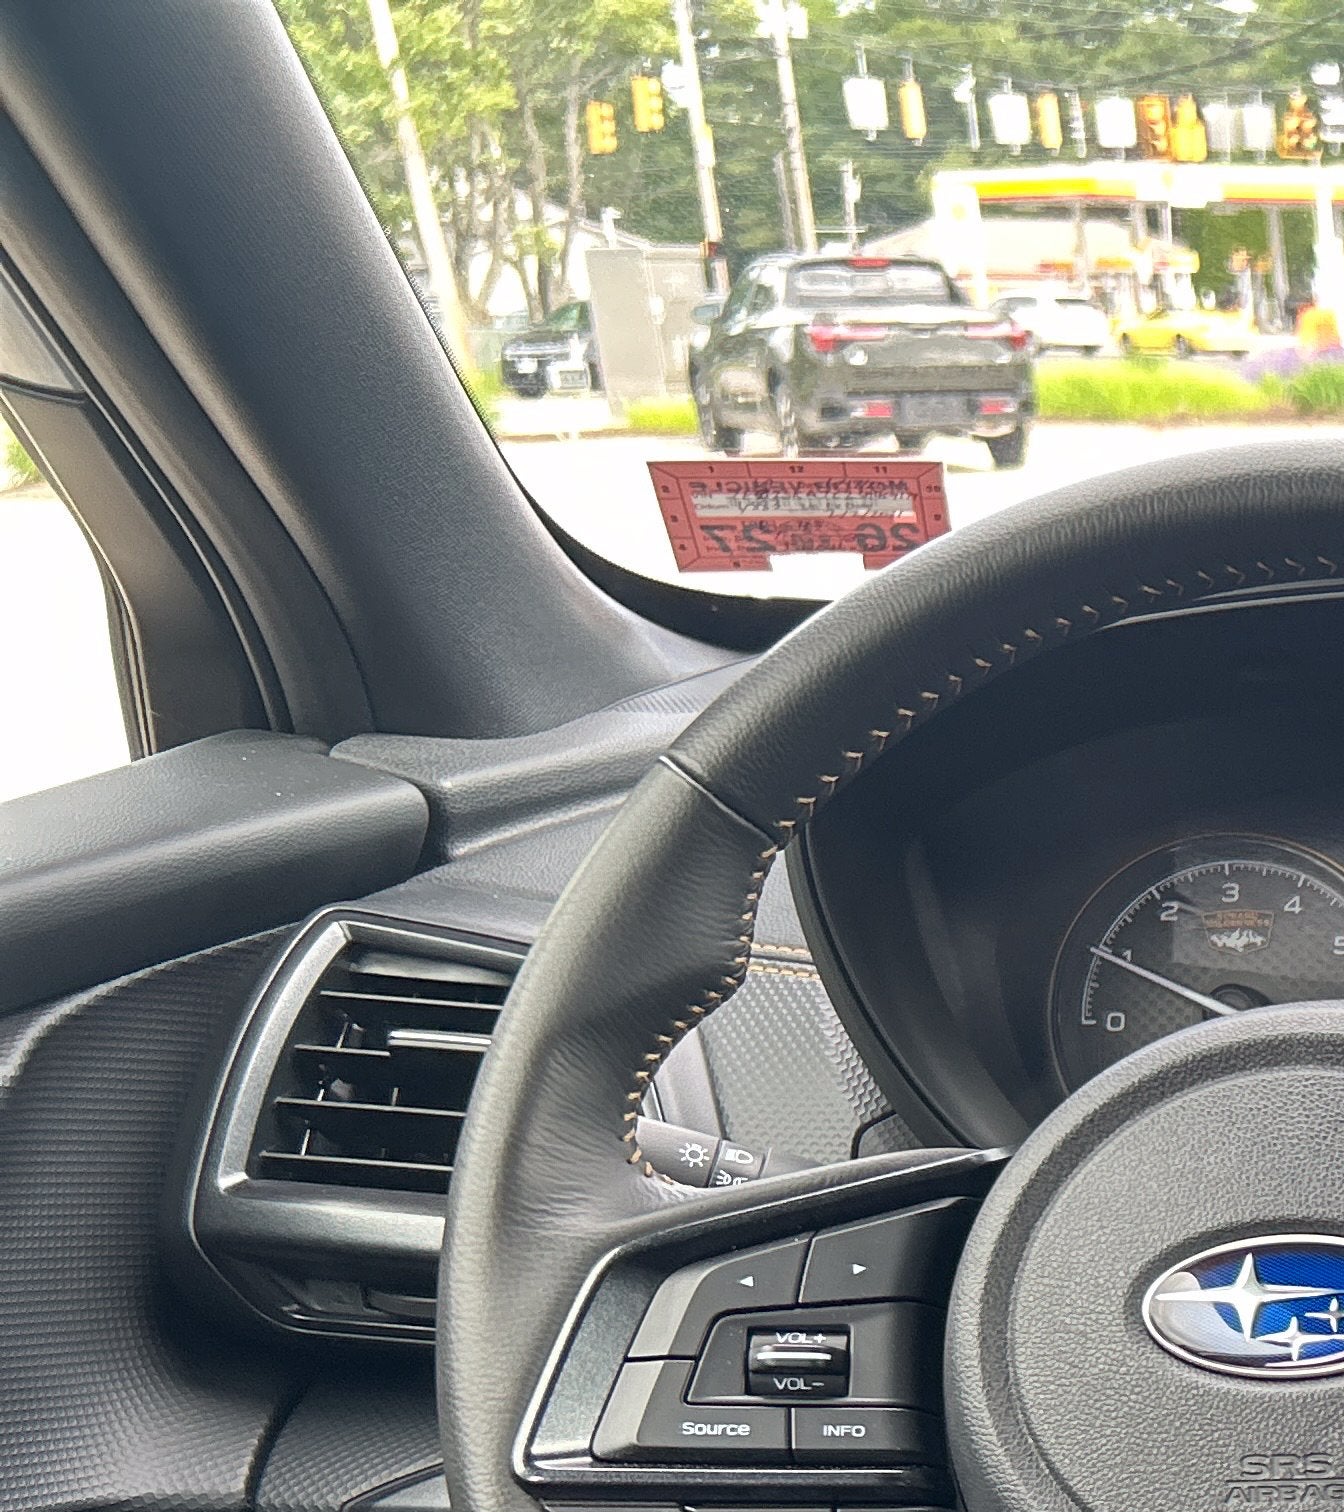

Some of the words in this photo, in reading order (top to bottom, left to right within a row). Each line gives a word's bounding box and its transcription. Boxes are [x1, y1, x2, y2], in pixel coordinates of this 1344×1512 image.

[1222, 883, 1240, 903] 3
[1160, 902, 1181, 922] 2
[1283, 896, 1302, 914] 4
[1105, 1012, 1126, 1032] 0
[682, 1421, 751, 1437] Source
[823, 1424, 866, 1438] INFO
[1240, 1453, 1336, 1479] SRS
